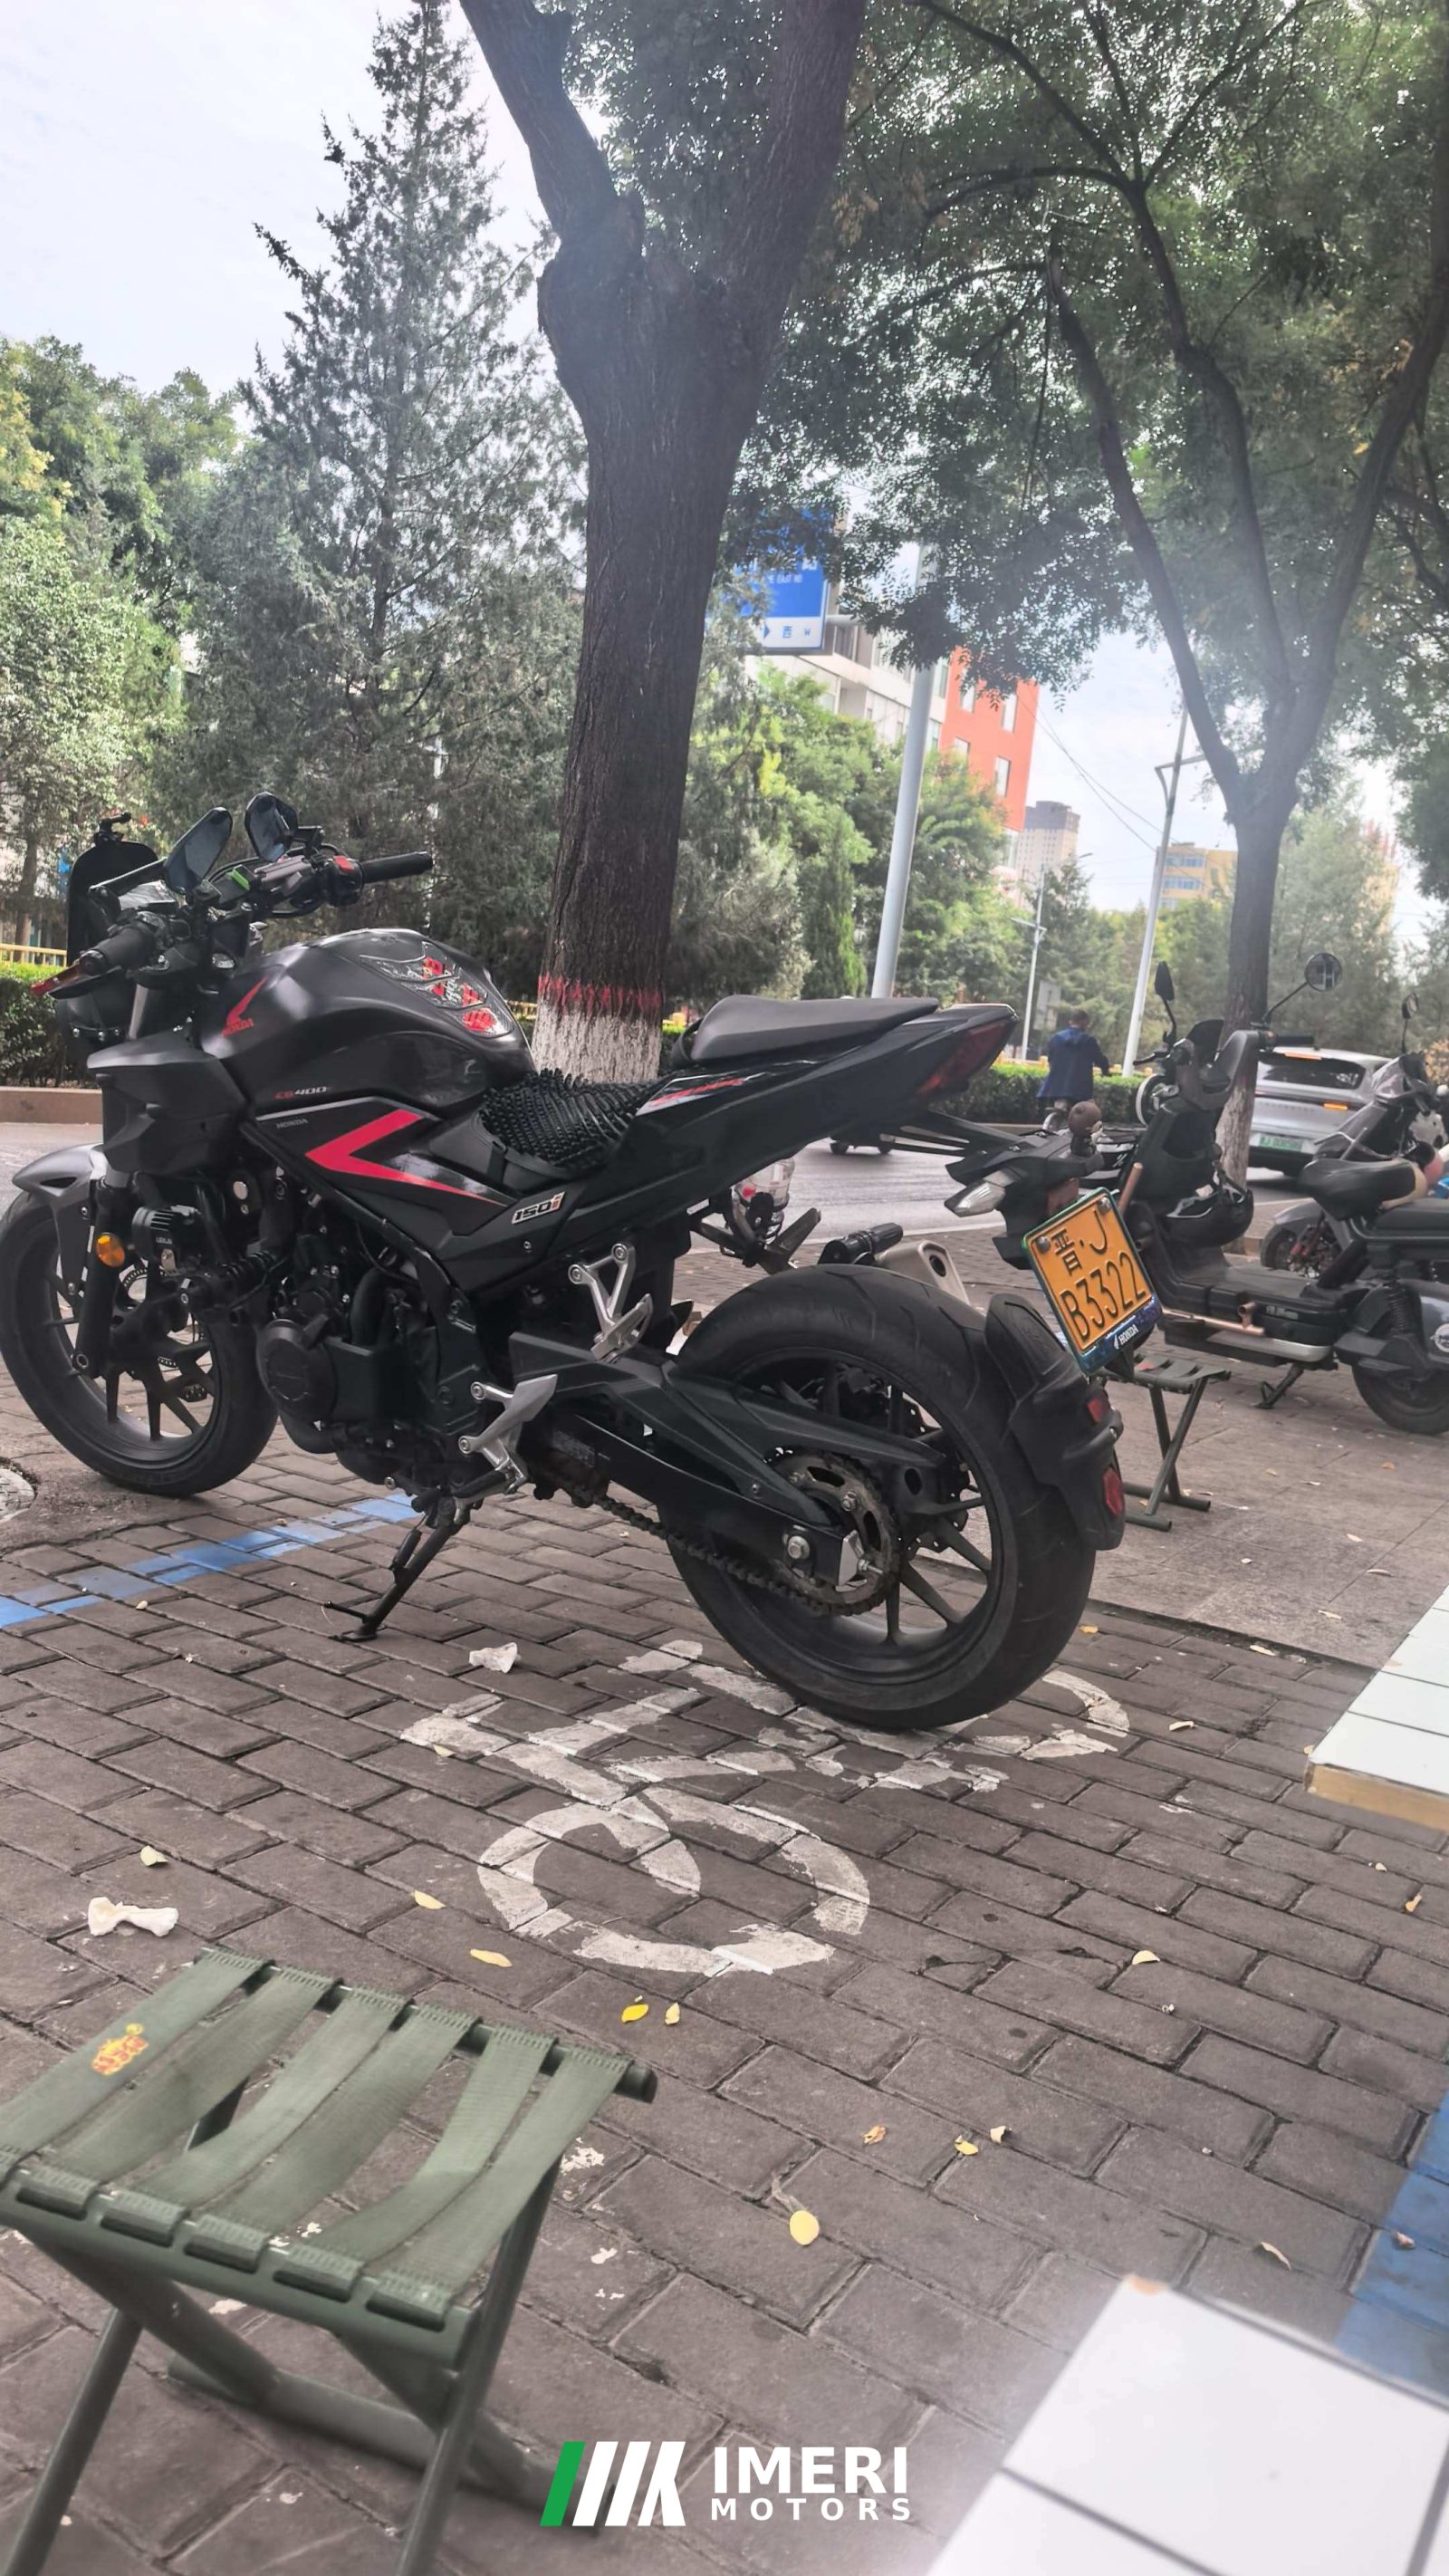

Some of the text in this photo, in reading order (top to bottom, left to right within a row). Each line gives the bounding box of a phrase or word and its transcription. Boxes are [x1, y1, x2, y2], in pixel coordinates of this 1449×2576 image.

[782, 625, 793, 639] 西
[515, 1196, 561, 1221] 150i
[1060, 1252, 1147, 1341] B3322
[1118, 1323, 1139, 1345] HONDA
